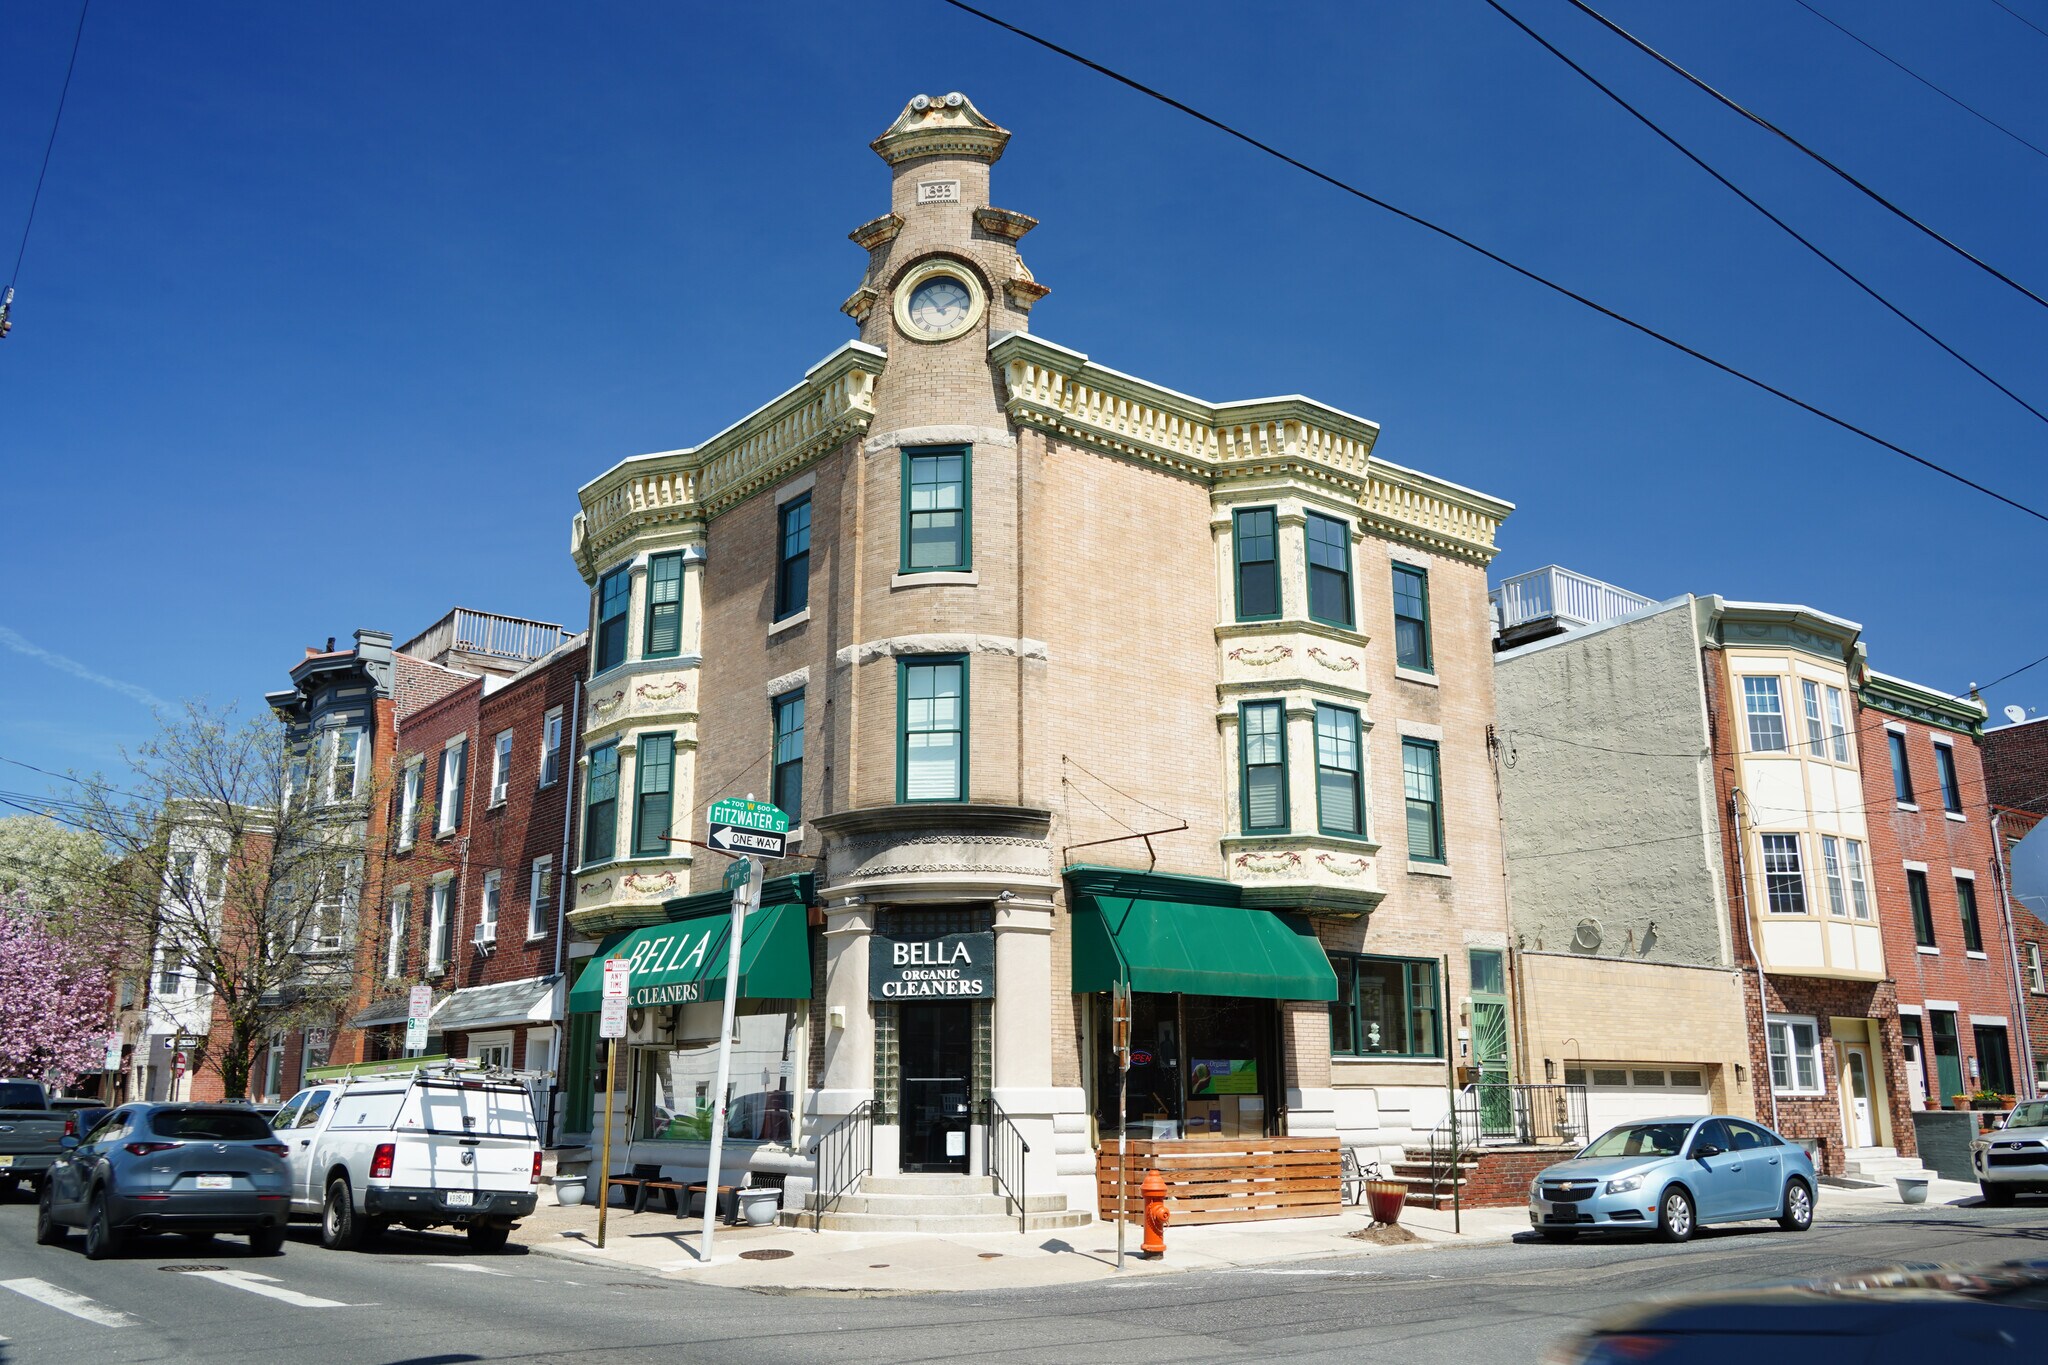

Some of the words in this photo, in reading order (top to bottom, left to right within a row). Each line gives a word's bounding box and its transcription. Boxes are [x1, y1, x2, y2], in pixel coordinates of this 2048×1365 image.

[747, 802, 755, 810] W
[714, 806, 772, 829] FITZWATER
[776, 820, 785, 831] ST
[732, 834, 752, 846] ONE
[756, 837, 778, 849] WAY
[743, 871, 750, 883] ST
[629, 930, 711, 974] BELLA
[893, 942, 972, 966] BELLA
[902, 969, 960, 981] ORGANIC
[637, 983, 698, 1005] CLEANERS
[882, 980, 983, 997] CLEANERS
[1130, 1054, 1152, 1062] OPEN
